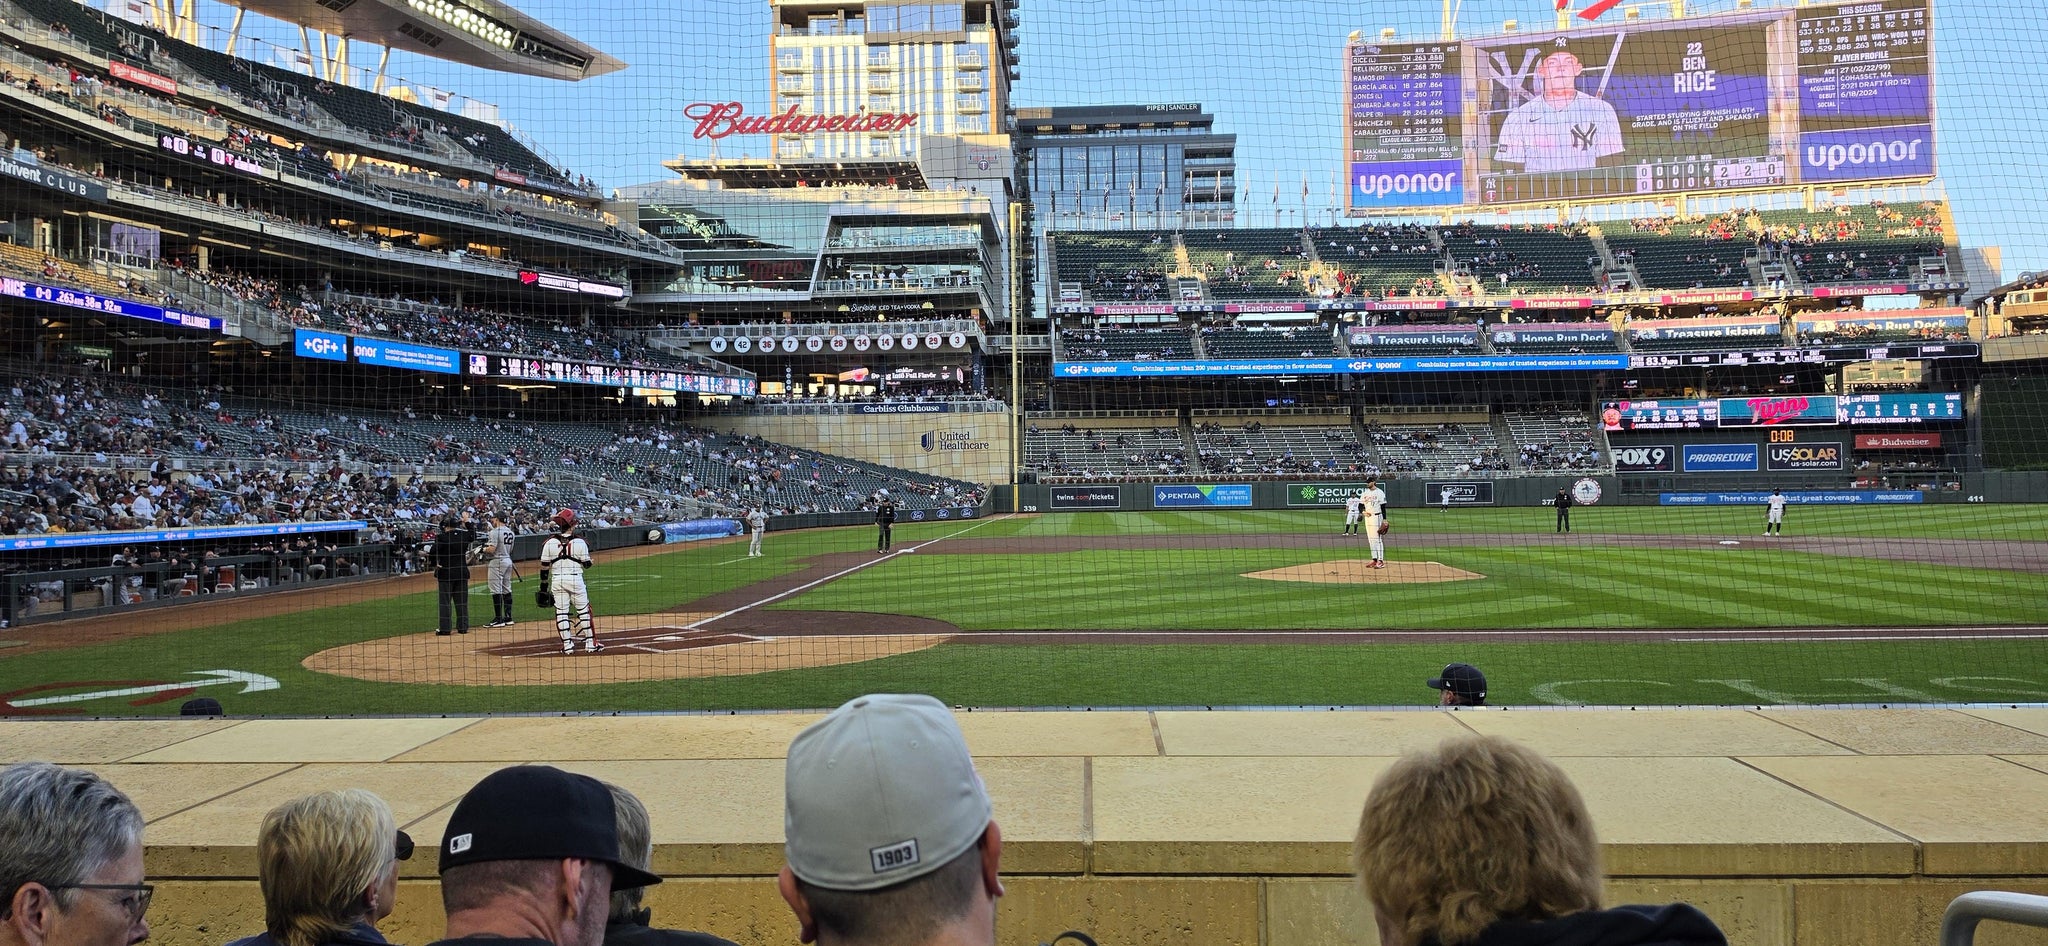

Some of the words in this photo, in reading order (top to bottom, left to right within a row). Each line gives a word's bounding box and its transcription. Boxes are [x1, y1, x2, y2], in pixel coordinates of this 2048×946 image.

[1838, 7, 1854, 15] THIS
[1855, 4, 1882, 13] SEASON
[1686, 42, 1703, 55] 22
[1834, 53, 1859, 63] PLAYER
[1860, 50, 1889, 61] PROFILE
[1682, 56, 1705, 71] BEN
[1674, 70, 1716, 93] RICE
[1840, 82, 1857, 90] 2021
[1840, 90, 1877, 98] 6/18/2024
[1147, 104, 1165, 112] PIPER
[1169, 103, 1198, 111] SANDLER
[684, 102, 918, 139] Budweiser
[1636, 114, 1666, 122] STARTED
[1667, 111, 1700, 120] STUDYING
[1702, 109, 1731, 117] SPANISH
[1353, 118, 1384, 127] SÁNCHEZ
[1632, 120, 1656, 128] GRADE,
[1681, 117, 1708, 125] FLUENT
[1808, 139, 1922, 170] uponor
[0, 157, 42, 183] hrivent
[47, 174, 86, 195] CLUB
[1360, 172, 1456, 199] uponor
[693, 265, 706, 277] WE
[709, 265, 724, 277] ARE
[727, 265, 741, 277] ALL
[1670, 294, 1712, 303] Treasure
[1714, 292, 1742, 301] Island
[1103, 306, 1138, 315] Treasure
[1140, 306, 1166, 314] Island
[1374, 302, 1410, 310] Treasure
[1412, 301, 1438, 309] Island
[1522, 334, 1554, 342] Home
[1557, 334, 1578, 342] Run
[1665, 329, 1721, 339] Treasure
[1723, 326, 1766, 336] Island
[929, 337, 938, 345] 29
[1378, 336, 1430, 345] Treasure
[1348, 362, 1373, 370] +GF+
[1376, 362, 1401, 370] uponor
[1646, 356, 1667, 366] 83.9
[1064, 366, 1089, 375] +GF+
[863, 405, 896, 413] Carbliss
[897, 405, 939, 413] Clubhouse
[1748, 397, 1809, 424] Twins
[940, 432, 970, 440] United
[1771, 430, 1793, 442] 0:08
[940, 440, 989, 450] Healthcare
[1882, 438, 1929, 446] Budweiser
[1616, 449, 1651, 465] FOX
[1652, 448, 1665, 465] 9
[1688, 453, 1754, 463] PROGRESSIVE
[1771, 447, 1838, 464] US/SOLAR
[1057, 493, 1114, 501] twins.com/tickets
[1318, 488, 1367, 497] secura
[503, 532, 513, 545] 22
[878, 846, 912, 866] 1903
